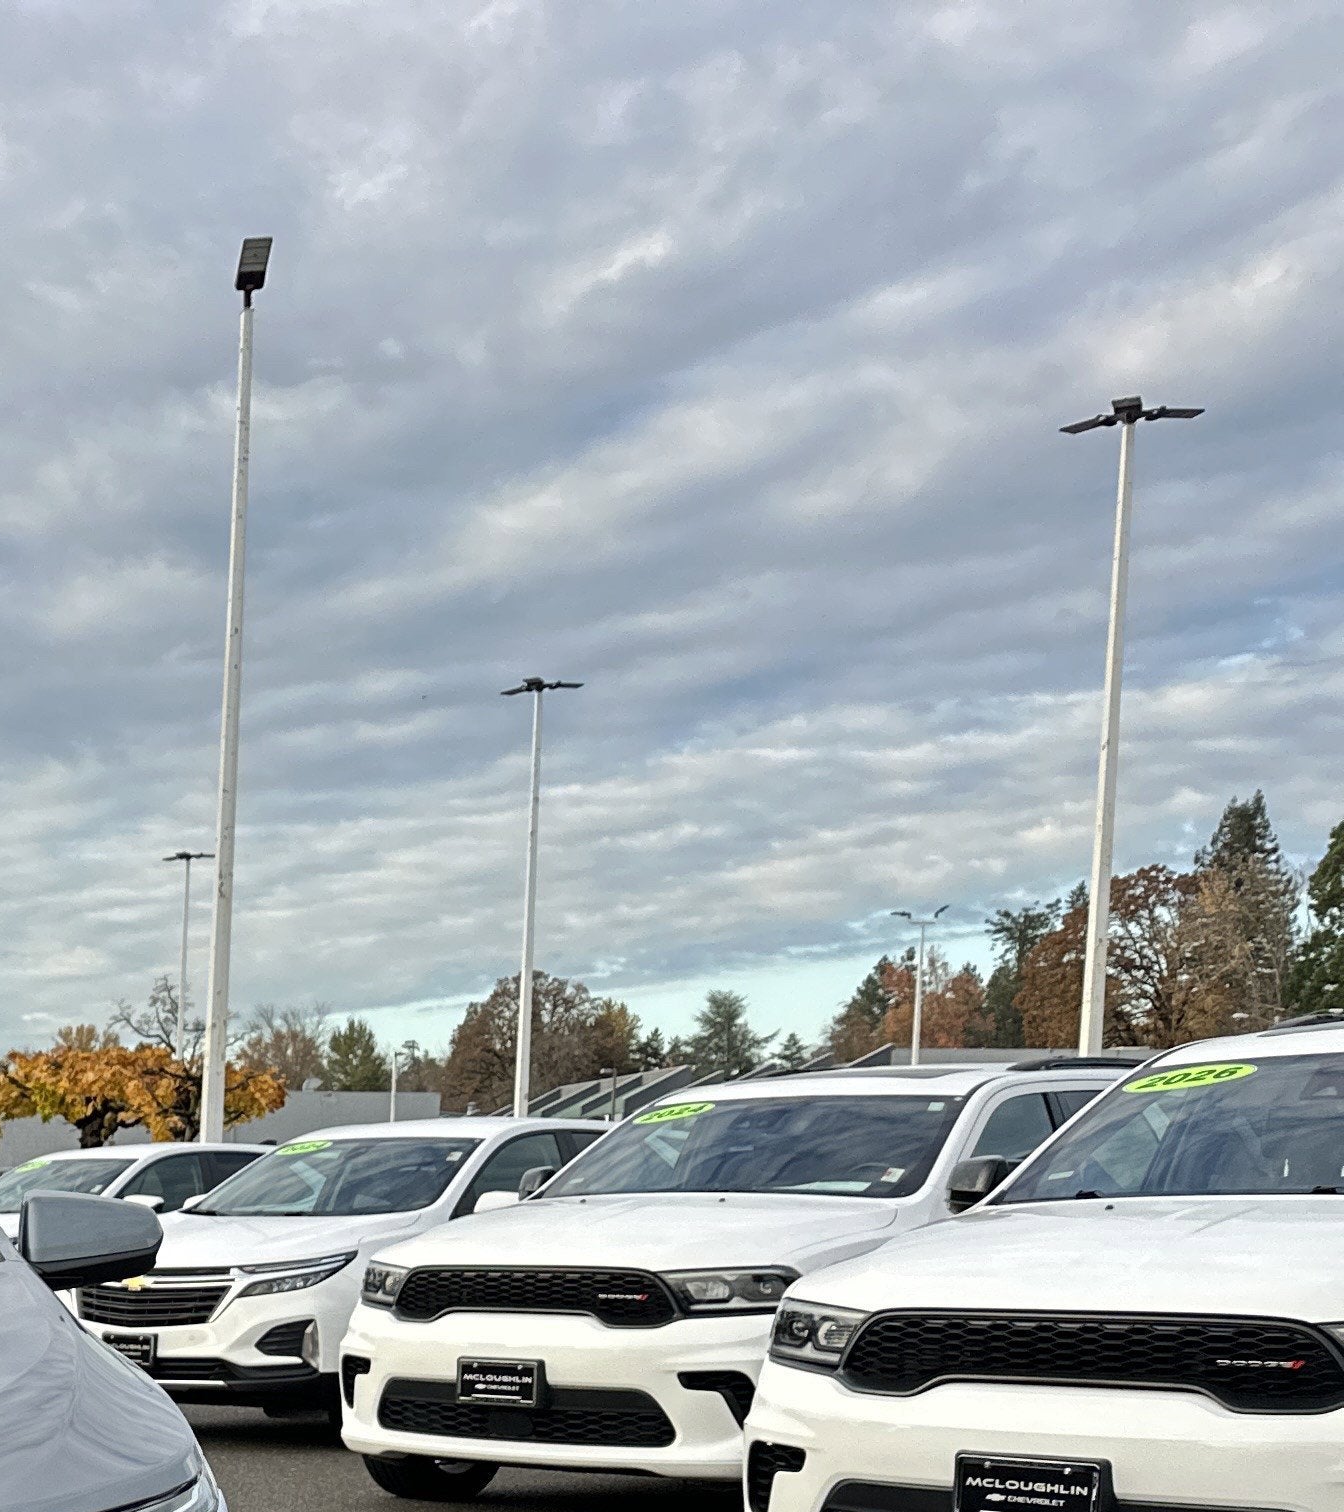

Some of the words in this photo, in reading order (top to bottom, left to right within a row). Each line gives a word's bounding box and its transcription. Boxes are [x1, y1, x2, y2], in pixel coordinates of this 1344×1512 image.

[1136, 1066, 1244, 1089] 2026
[965, 1477, 1089, 1496] MCLOUGHLIN
[1007, 1495, 1066, 1507] CHEVROLET
